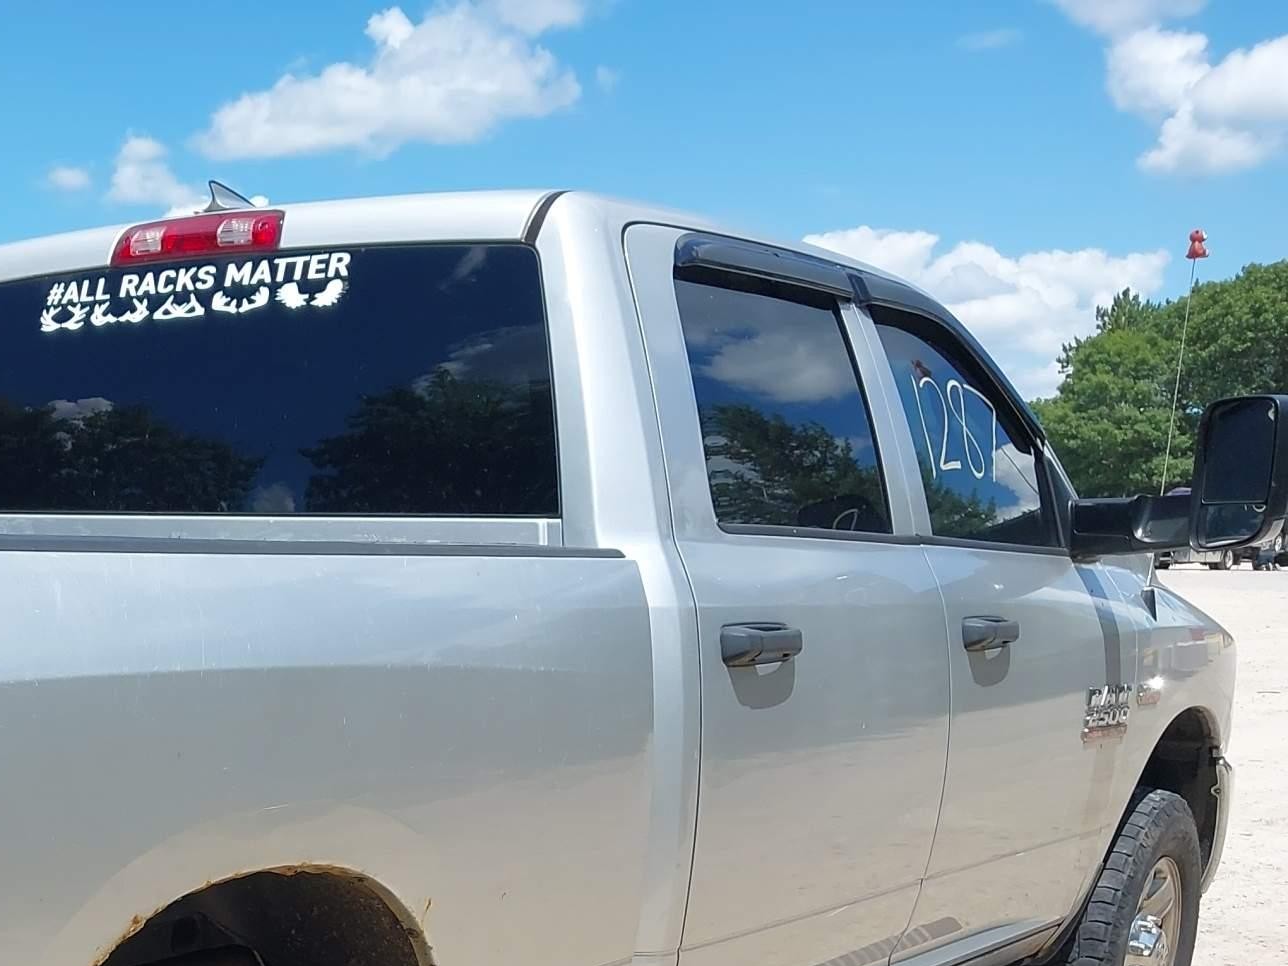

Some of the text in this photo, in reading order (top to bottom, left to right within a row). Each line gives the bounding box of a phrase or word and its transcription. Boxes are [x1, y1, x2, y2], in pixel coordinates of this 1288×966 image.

[46, 252, 352, 305] #ALL RACKS MATTER
[910, 374, 997, 483] 1287
[1084, 705, 1130, 727] 2500
